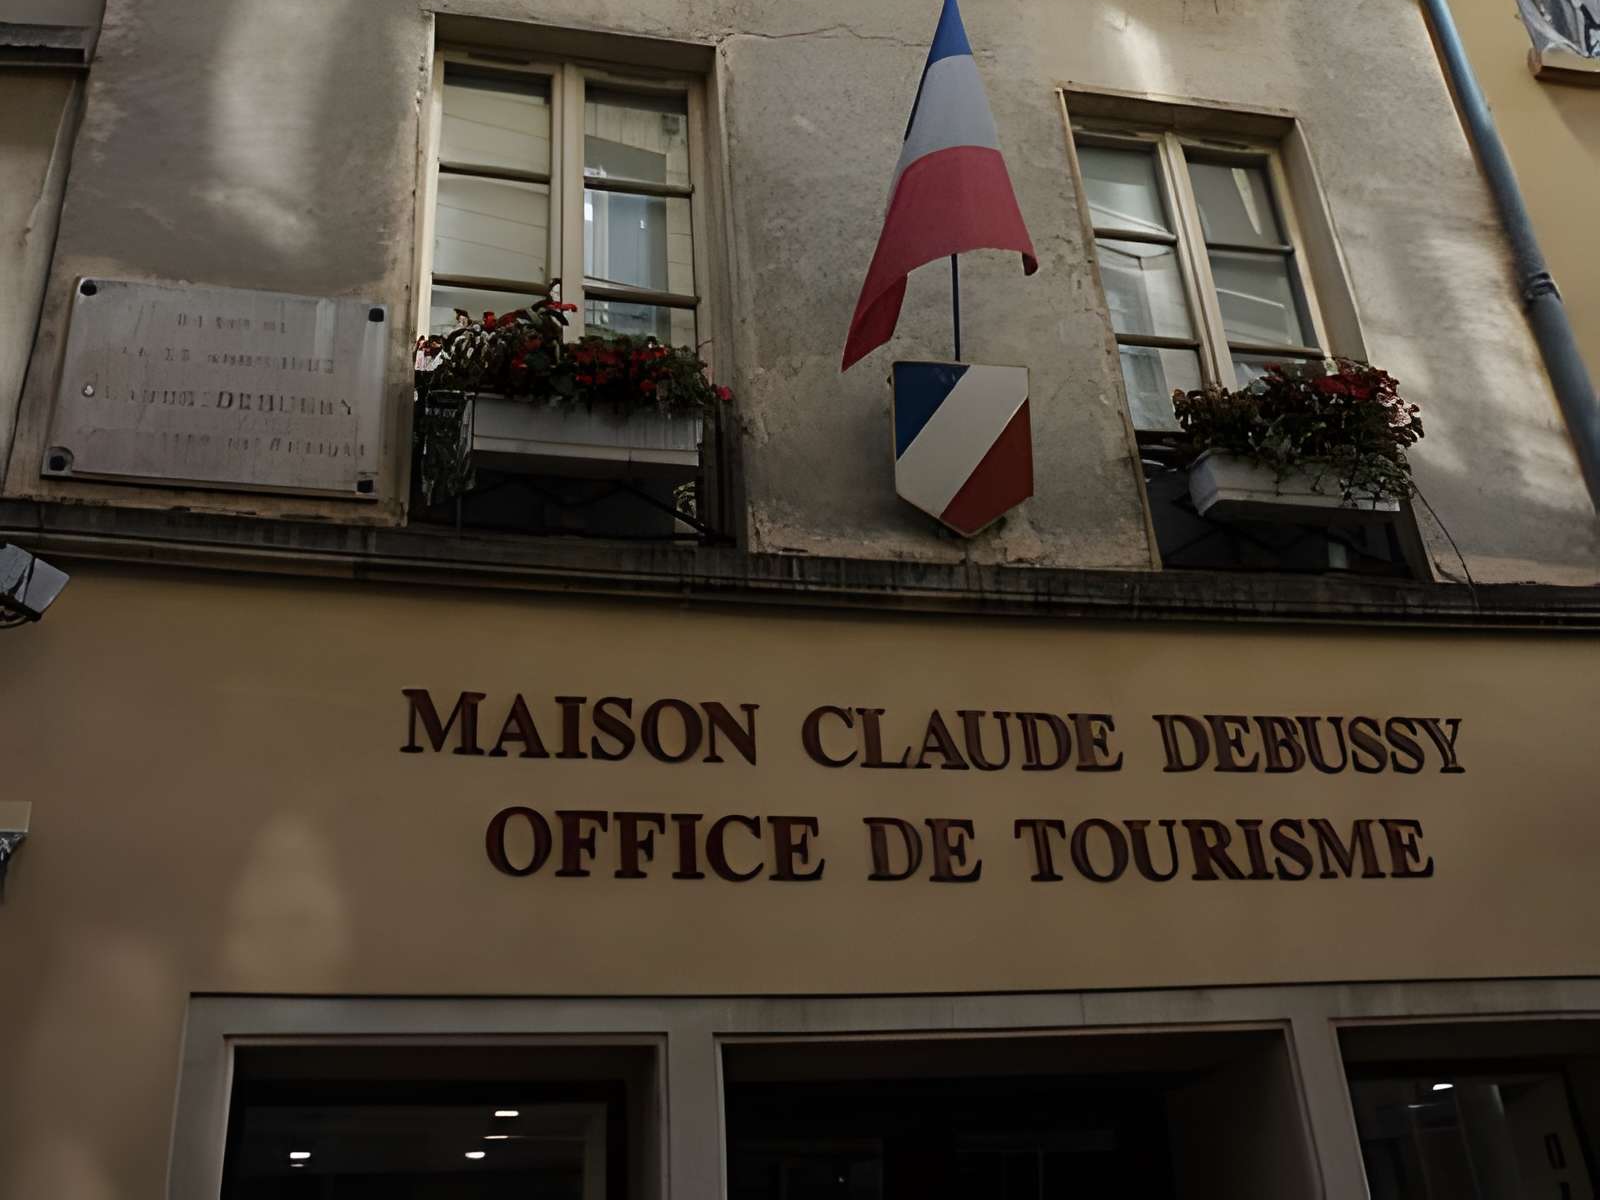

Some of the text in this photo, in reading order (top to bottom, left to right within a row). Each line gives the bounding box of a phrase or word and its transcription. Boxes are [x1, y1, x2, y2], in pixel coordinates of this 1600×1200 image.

[400, 689, 1465, 774] MAISON CLAUDE DEBUSSY
[485, 806, 1434, 884] OFFICE DE TOURISME
